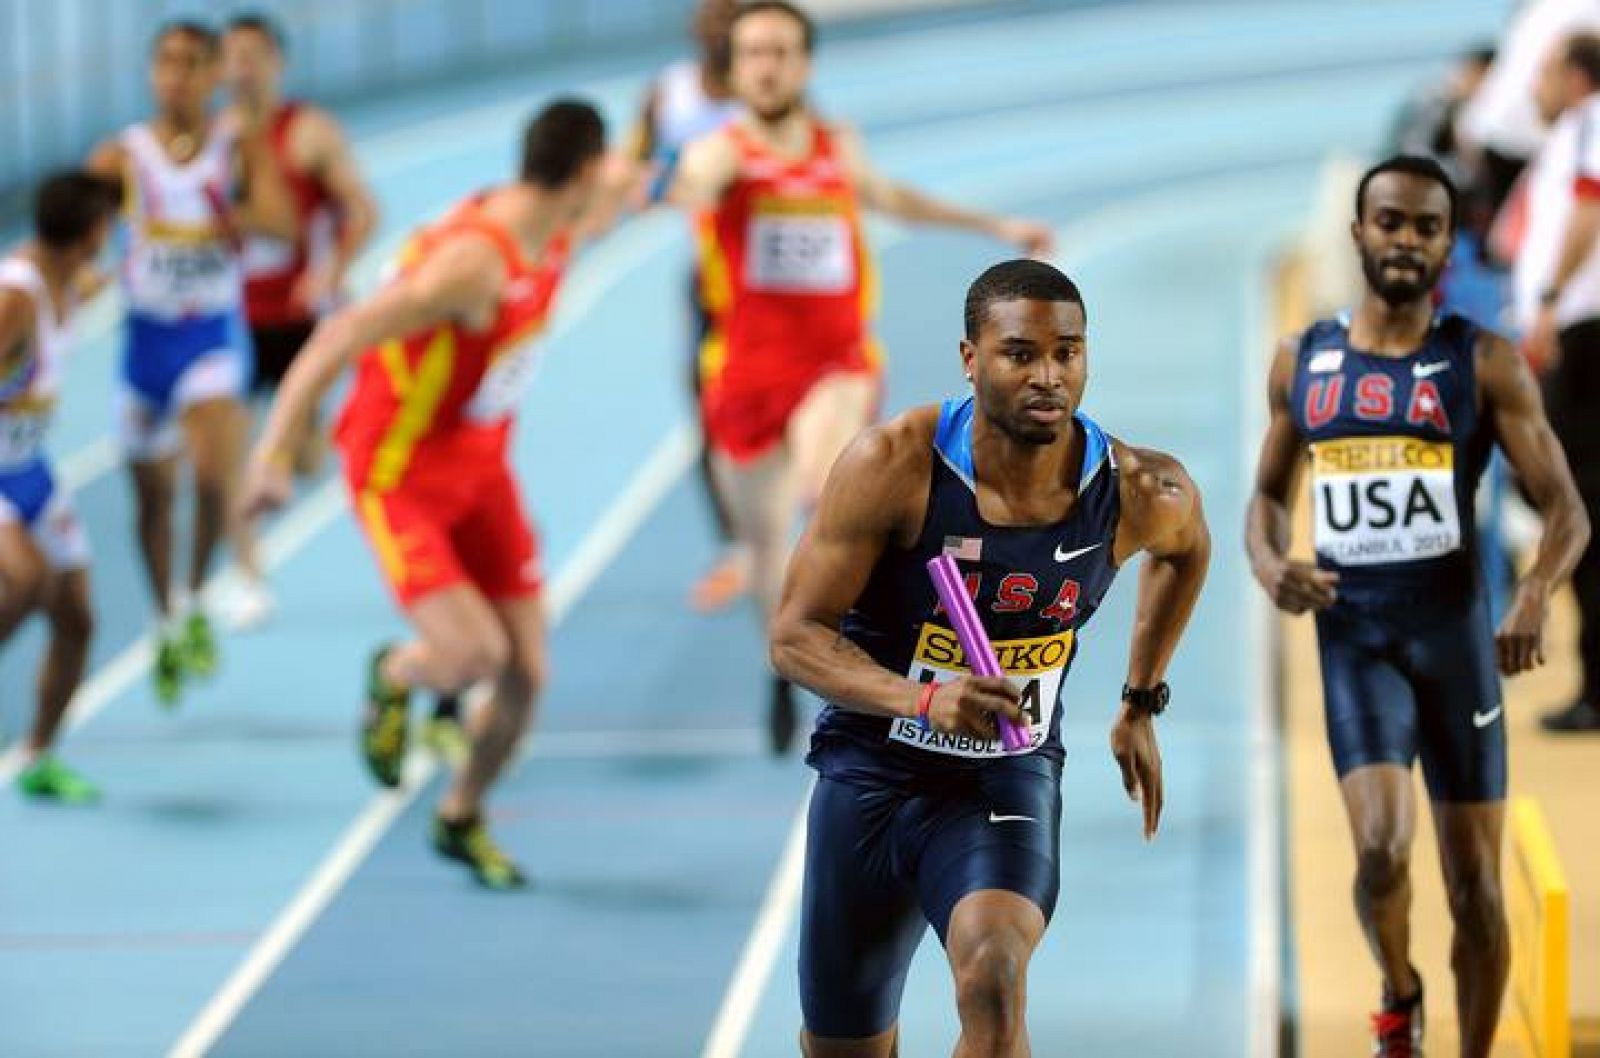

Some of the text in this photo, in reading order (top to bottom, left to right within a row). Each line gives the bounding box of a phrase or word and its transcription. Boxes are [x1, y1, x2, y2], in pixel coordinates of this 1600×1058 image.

[1305, 373, 1450, 431] USA
[1321, 443, 1446, 470] SEIKO
[1322, 476, 1444, 532] USA
